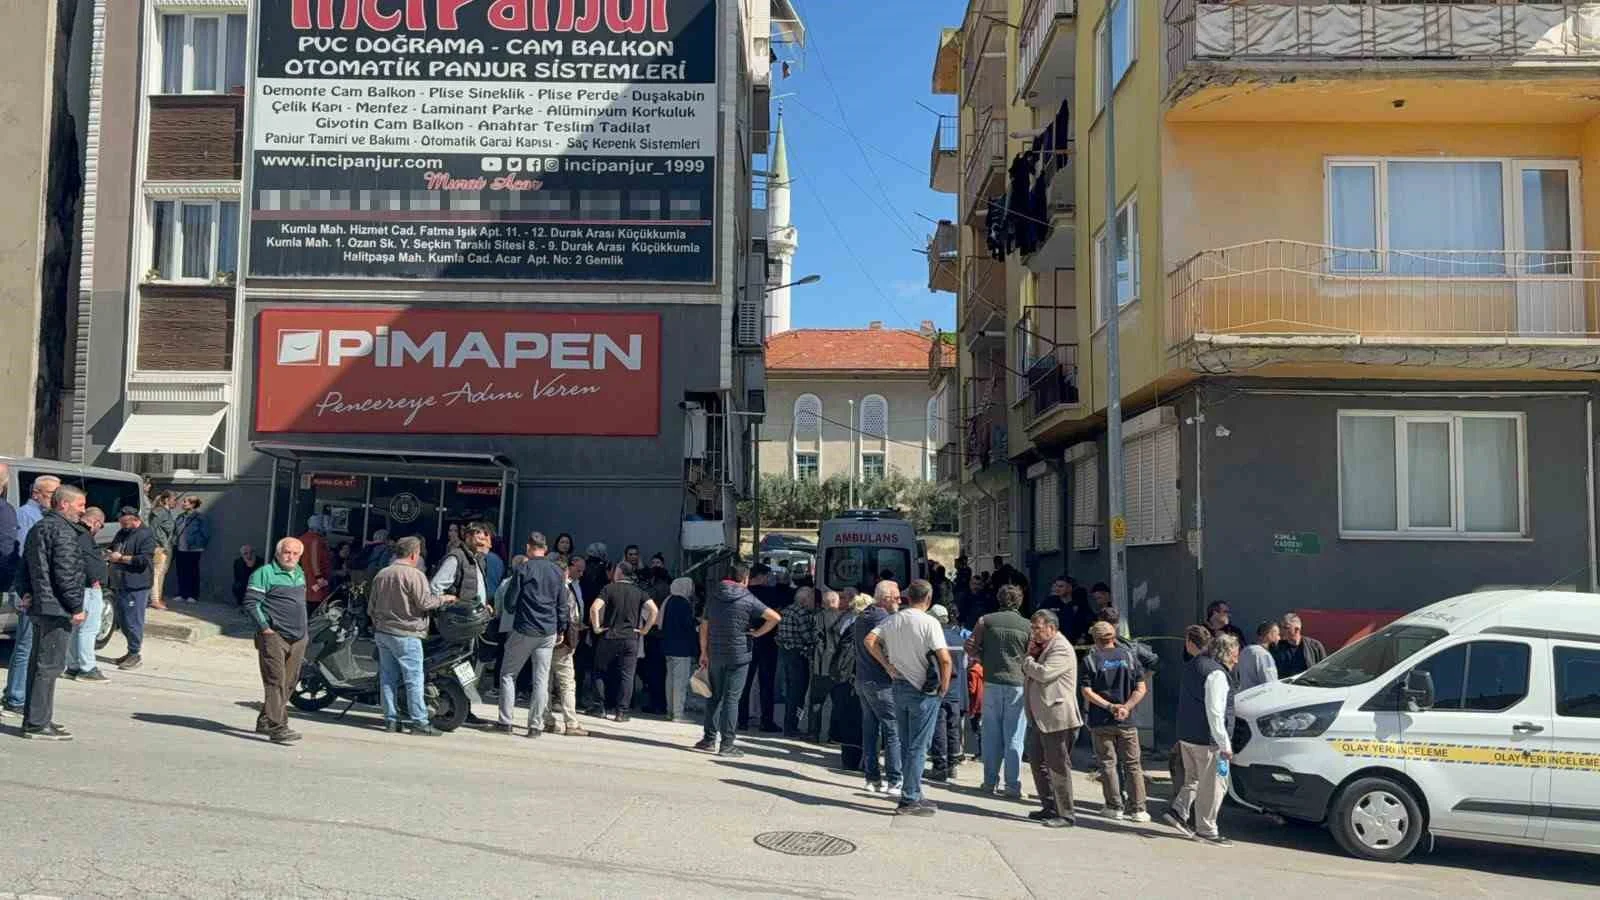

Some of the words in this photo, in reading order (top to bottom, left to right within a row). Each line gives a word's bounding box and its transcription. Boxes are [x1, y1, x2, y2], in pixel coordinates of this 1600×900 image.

[299, 37, 347, 52] PVC
[355, 35, 484, 54] DOĞRAMA
[506, 39, 563, 55] CAM
[571, 40, 674, 56] BALKON
[285, 57, 421, 77] OTOMATİK
[429, 61, 526, 78] PANJUR
[534, 59, 686, 80] SİSTEMLERİ
[263, 85, 326, 97] Demonte
[331, 86, 362, 97] Cam
[367, 86, 416, 98] Balkon
[429, 87, 464, 99] Plise
[468, 87, 525, 99] Sineklik
[538, 88, 572, 100] Plise
[577, 89, 618, 100] Perde
[632, 90, 705, 104] Duşakabin
[271, 101, 307, 114] Çelik
[356, 102, 408, 114] Menfez
[421, 103, 487, 115] Laminant
[492, 104, 534, 116] Parke
[547, 105, 627, 118] Alüminyum
[632, 106, 696, 118] Korkuluk
[315, 117, 369, 130] Giyotin
[374, 118, 407, 130] Cam
[413, 119, 464, 131] Balkon
[478, 120, 537, 132] Anahtar
[544, 121, 594, 132] Teslim
[265, 132, 304, 145] Panjur
[308, 133, 347, 145] Tamiri
[351, 136, 365, 145] ve
[421, 135, 476, 147] Otomatik
[479, 136, 512, 148] Garaj
[567, 138, 588, 151] Saç
[592, 138, 636, 149] Kepenk
[639, 139, 700, 150] Sistemleri
[261, 153, 443, 171] www.incipanjur.com
[565, 158, 705, 175] incipanjur_1999
[281, 224, 317, 234] Kumla
[320, 224, 346, 235] Mah.
[350, 224, 388, 235] Hizmet
[391, 225, 416, 236] Cad.
[419, 226, 454, 236] Fatma
[480, 227, 501, 238] Apt.
[506, 227, 521, 237] 11.
[533, 227, 547, 237] 12.
[551, 228, 583, 238] Durak
[618, 228, 686, 241] Küçükkumla
[267, 237, 301, 247] Kumla
[305, 237, 332, 247] Mah.
[348, 238, 376, 248] Ozan
[379, 238, 397, 249] Sk.
[400, 239, 410, 249] Y.
[413, 239, 451, 251] Seçkin
[494, 240, 525, 250] Sitesi
[561, 241, 594, 251] Durak
[632, 242, 700, 254] Küçükkumla
[343, 251, 395, 264] Halitpaşa
[399, 252, 425, 262] Mah.
[428, 253, 464, 263] Kumla
[467, 254, 492, 264] Cad.
[495, 254, 521, 264] Acar
[527, 255, 550, 266] Apt.
[553, 255, 572, 265] No:
[576, 256, 582, 265] 2
[585, 255, 624, 265] Gemlik
[316, 391, 437, 426] Pencereye
[533, 373, 600, 400] Veren
[835, 532, 898, 544] AMBULANS
[1342, 743, 1368, 752] OLAY
[1494, 752, 1520, 762] OLAY
